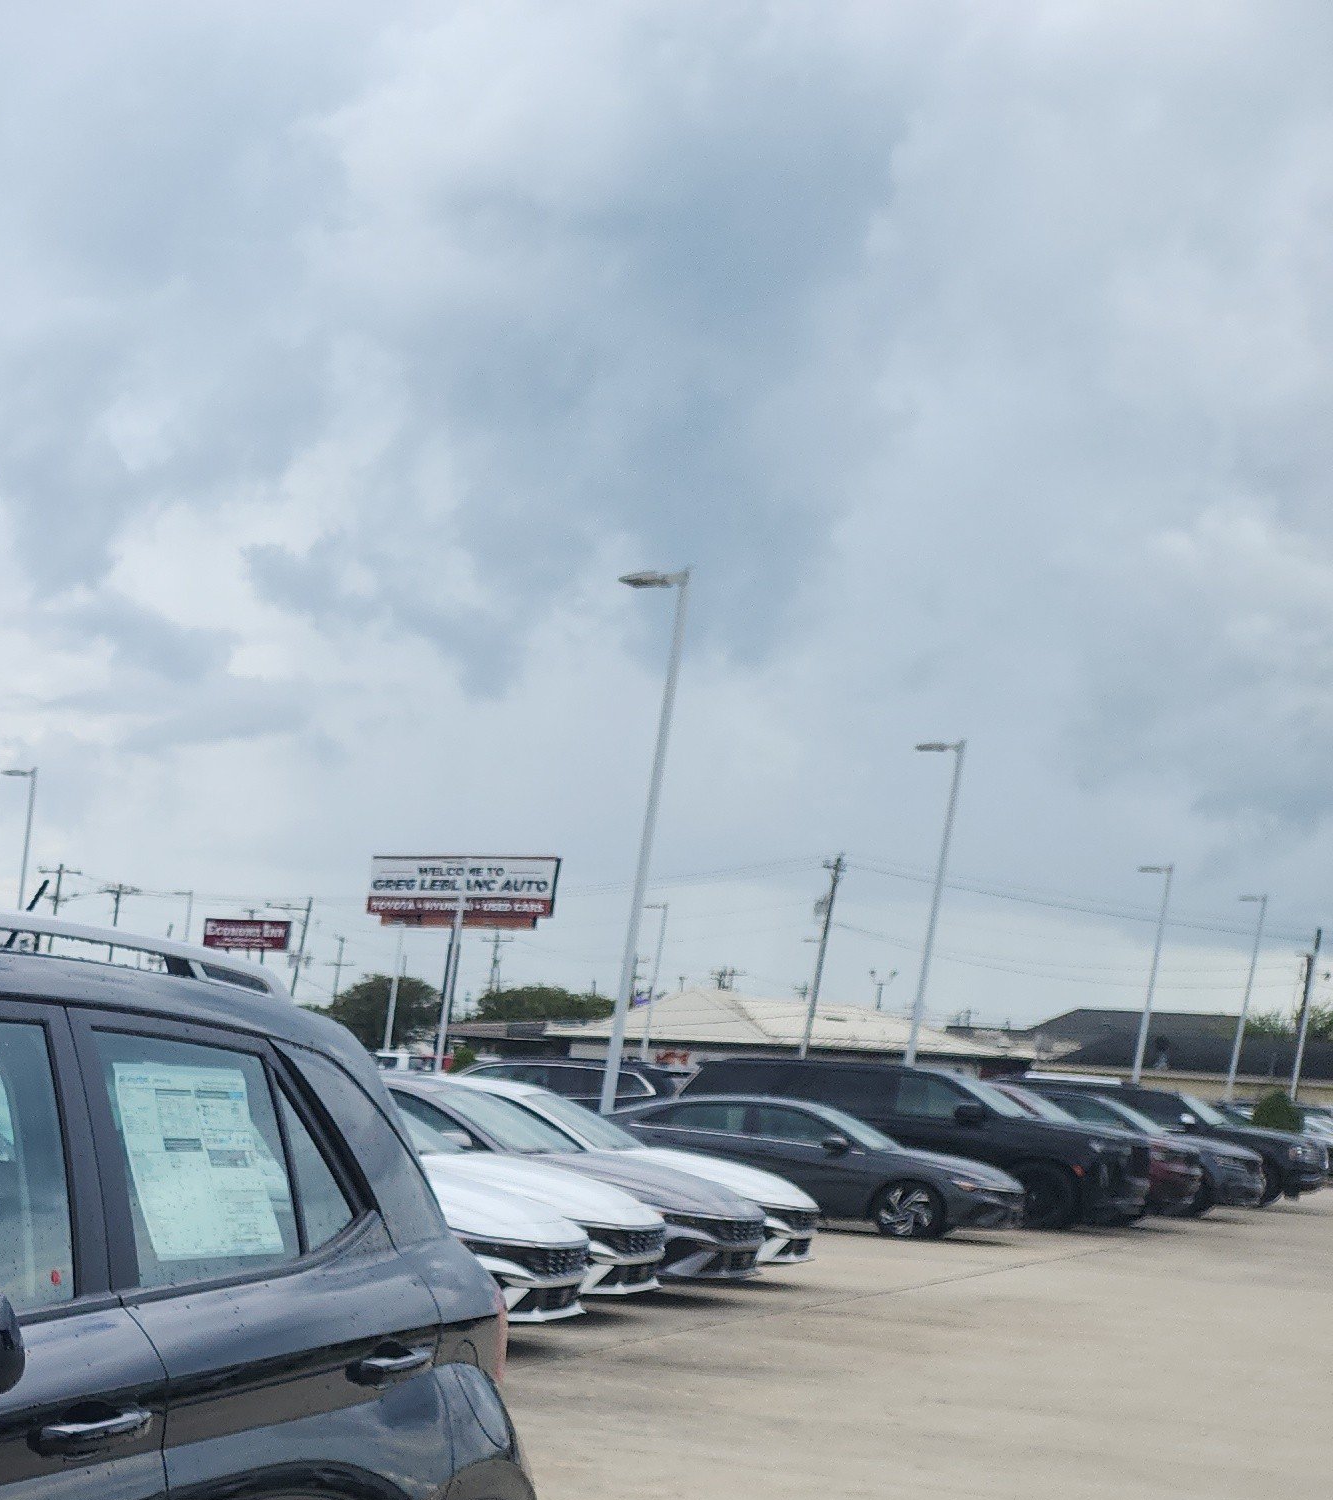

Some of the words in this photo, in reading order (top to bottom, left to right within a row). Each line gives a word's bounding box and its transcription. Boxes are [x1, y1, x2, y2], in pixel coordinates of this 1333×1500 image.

[486, 867, 505, 876] TO
[372, 879, 416, 891] GREG
[500, 879, 548, 892] AUTO
[370, 901, 415, 910] TOYOTA
[482, 902, 512, 911] USED
